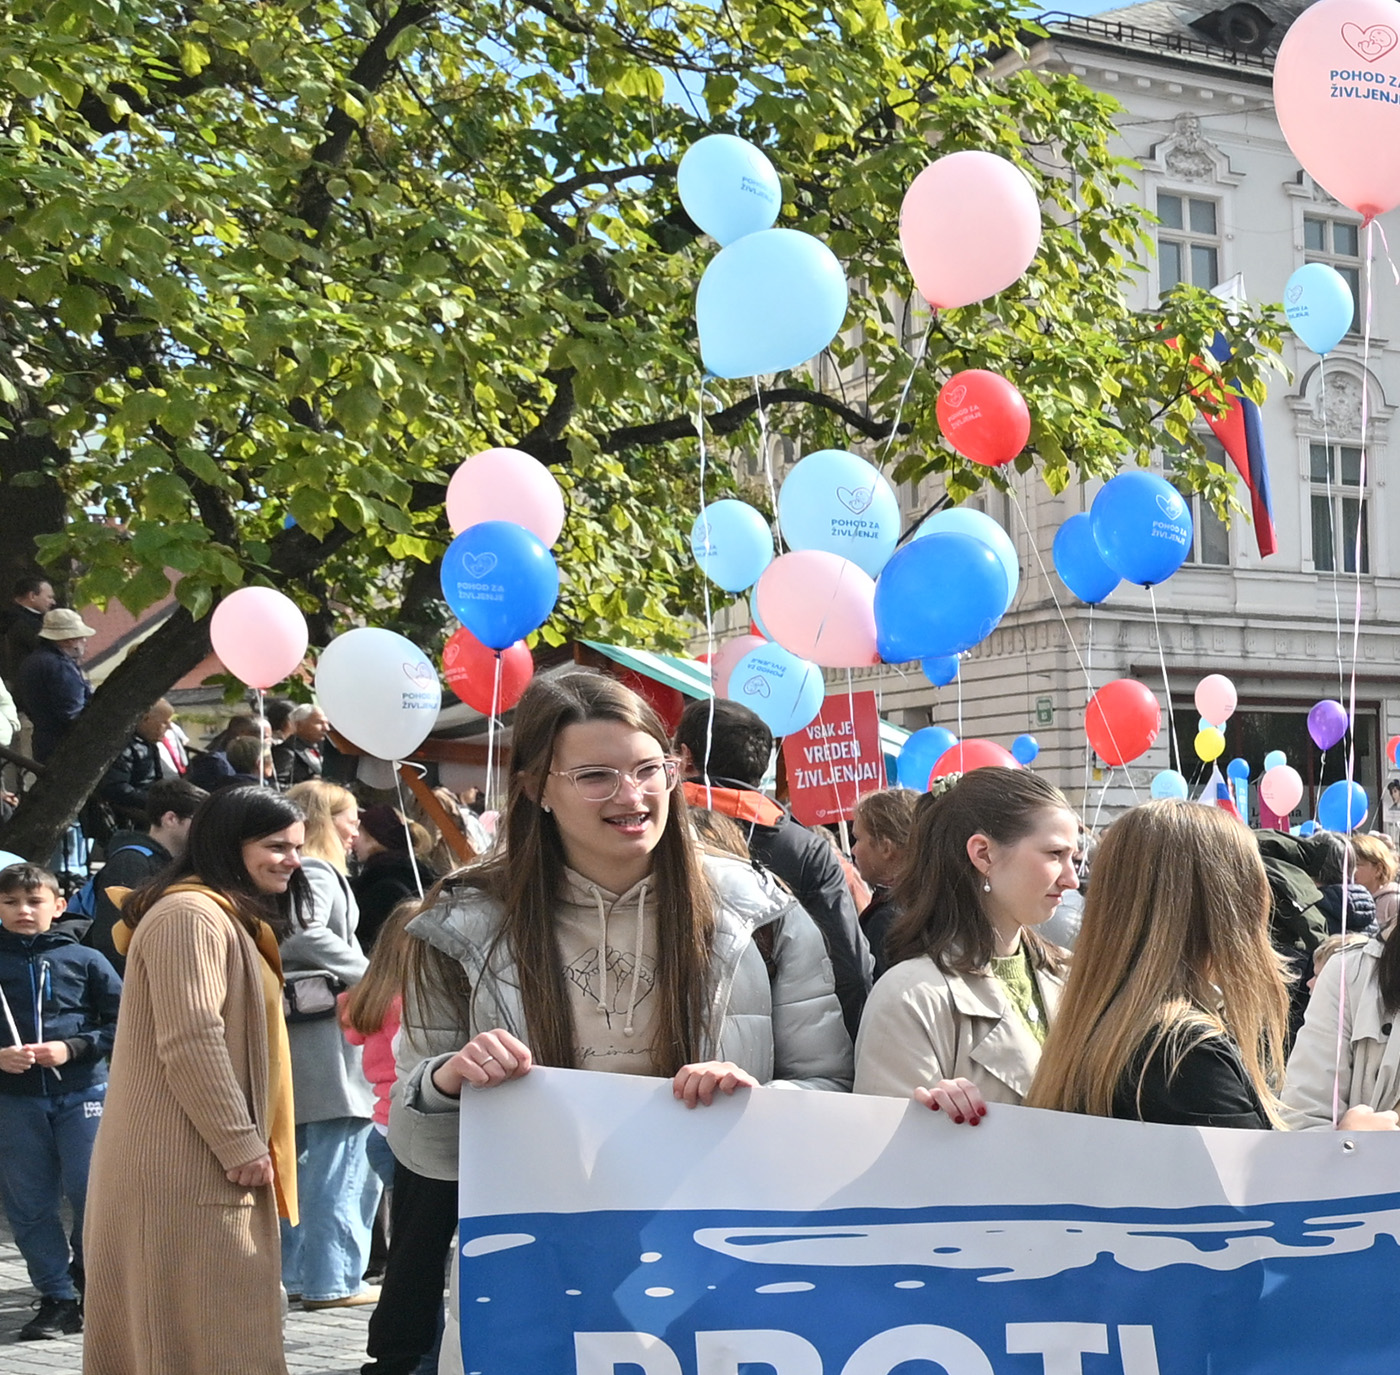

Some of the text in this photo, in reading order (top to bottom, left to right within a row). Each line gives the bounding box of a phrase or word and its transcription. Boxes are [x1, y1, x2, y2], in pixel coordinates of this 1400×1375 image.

[1330, 69, 1385, 84] POHOD
[831, 518, 880, 530] POHOD ZA
[806, 721, 853, 740] VSAK JE
[803, 740, 861, 764] VREDEN
[795, 761, 877, 790] ŽIVLJENJA!
